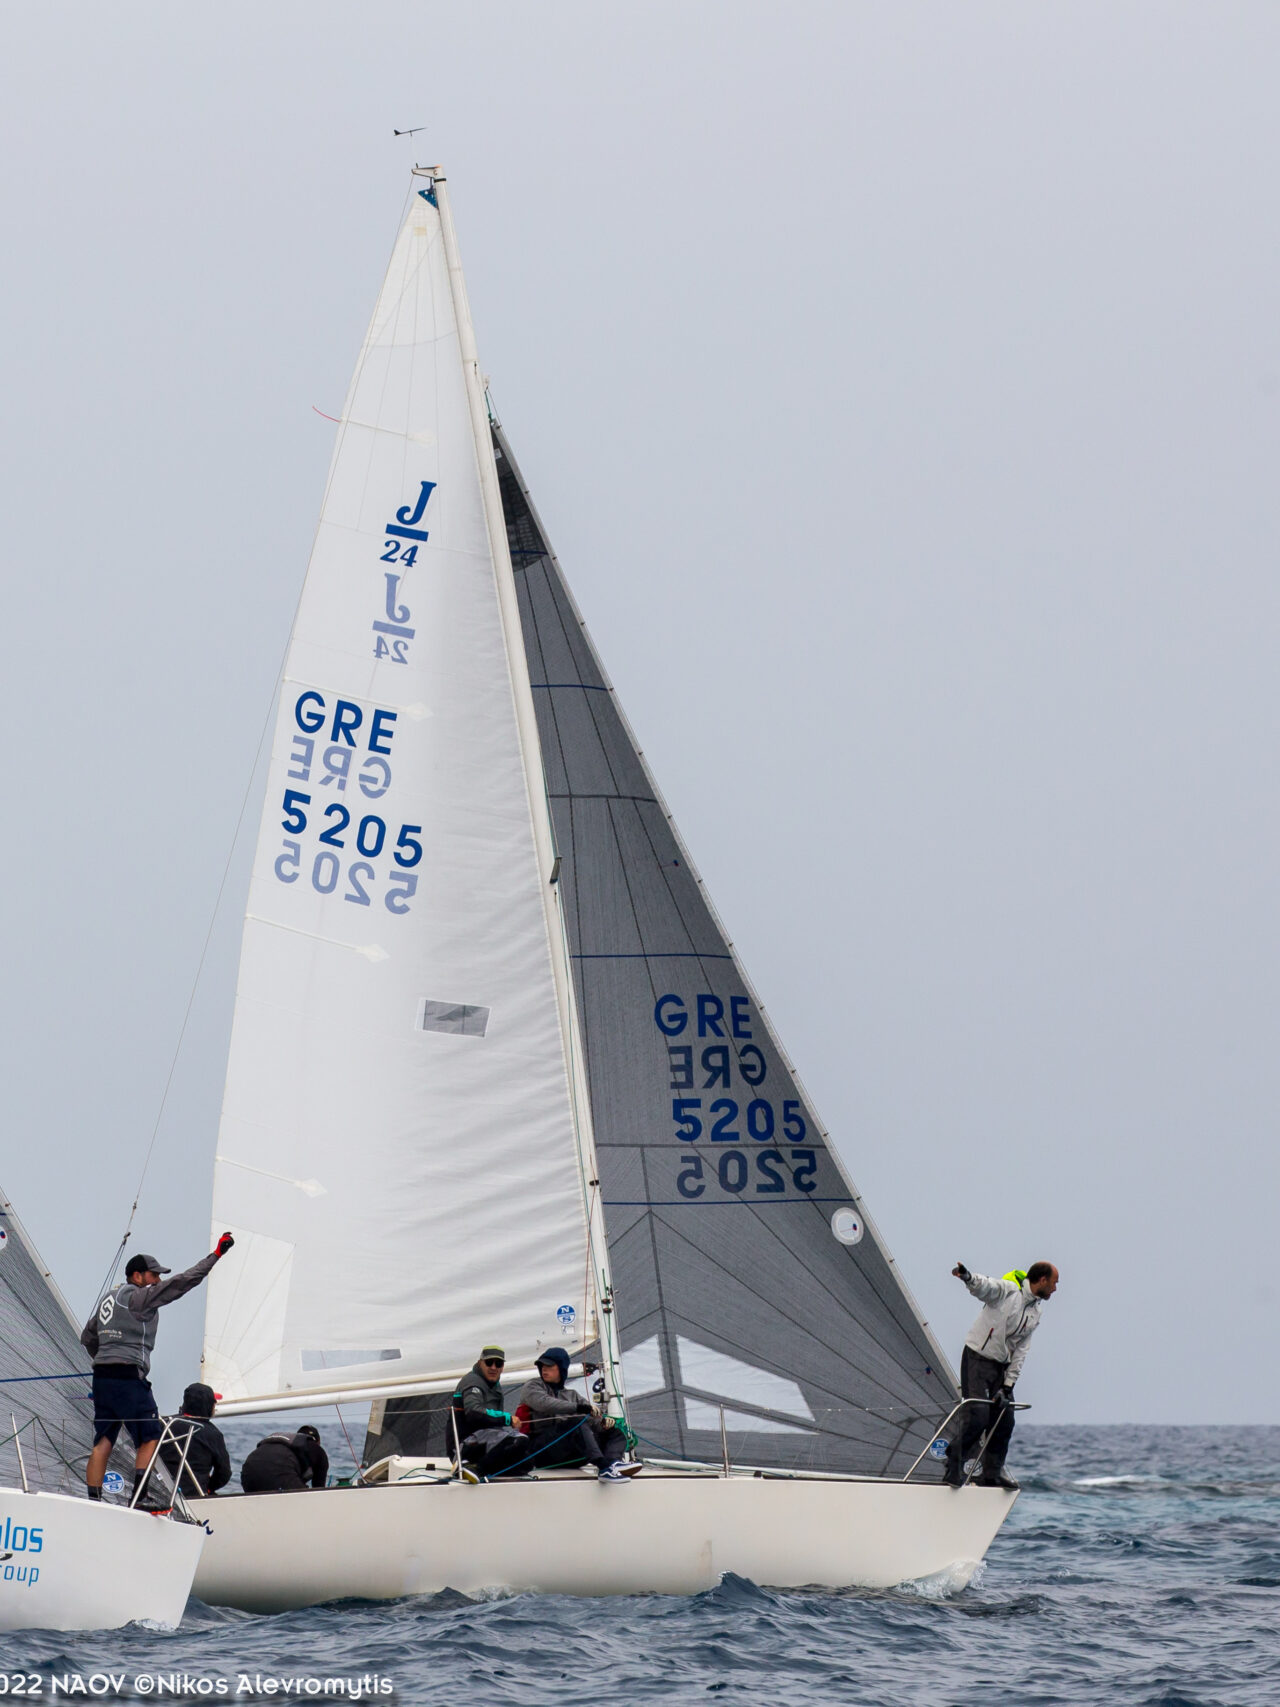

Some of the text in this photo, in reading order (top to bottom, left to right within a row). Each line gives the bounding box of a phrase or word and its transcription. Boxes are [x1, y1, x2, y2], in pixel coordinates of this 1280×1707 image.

[396, 480, 438, 526] J
[380, 540, 419, 567] 24
[295, 691, 398, 755] GRE
[282, 789, 424, 868] 5205
[654, 993, 753, 1039] GRE
[672, 1098, 807, 1142] 5205
